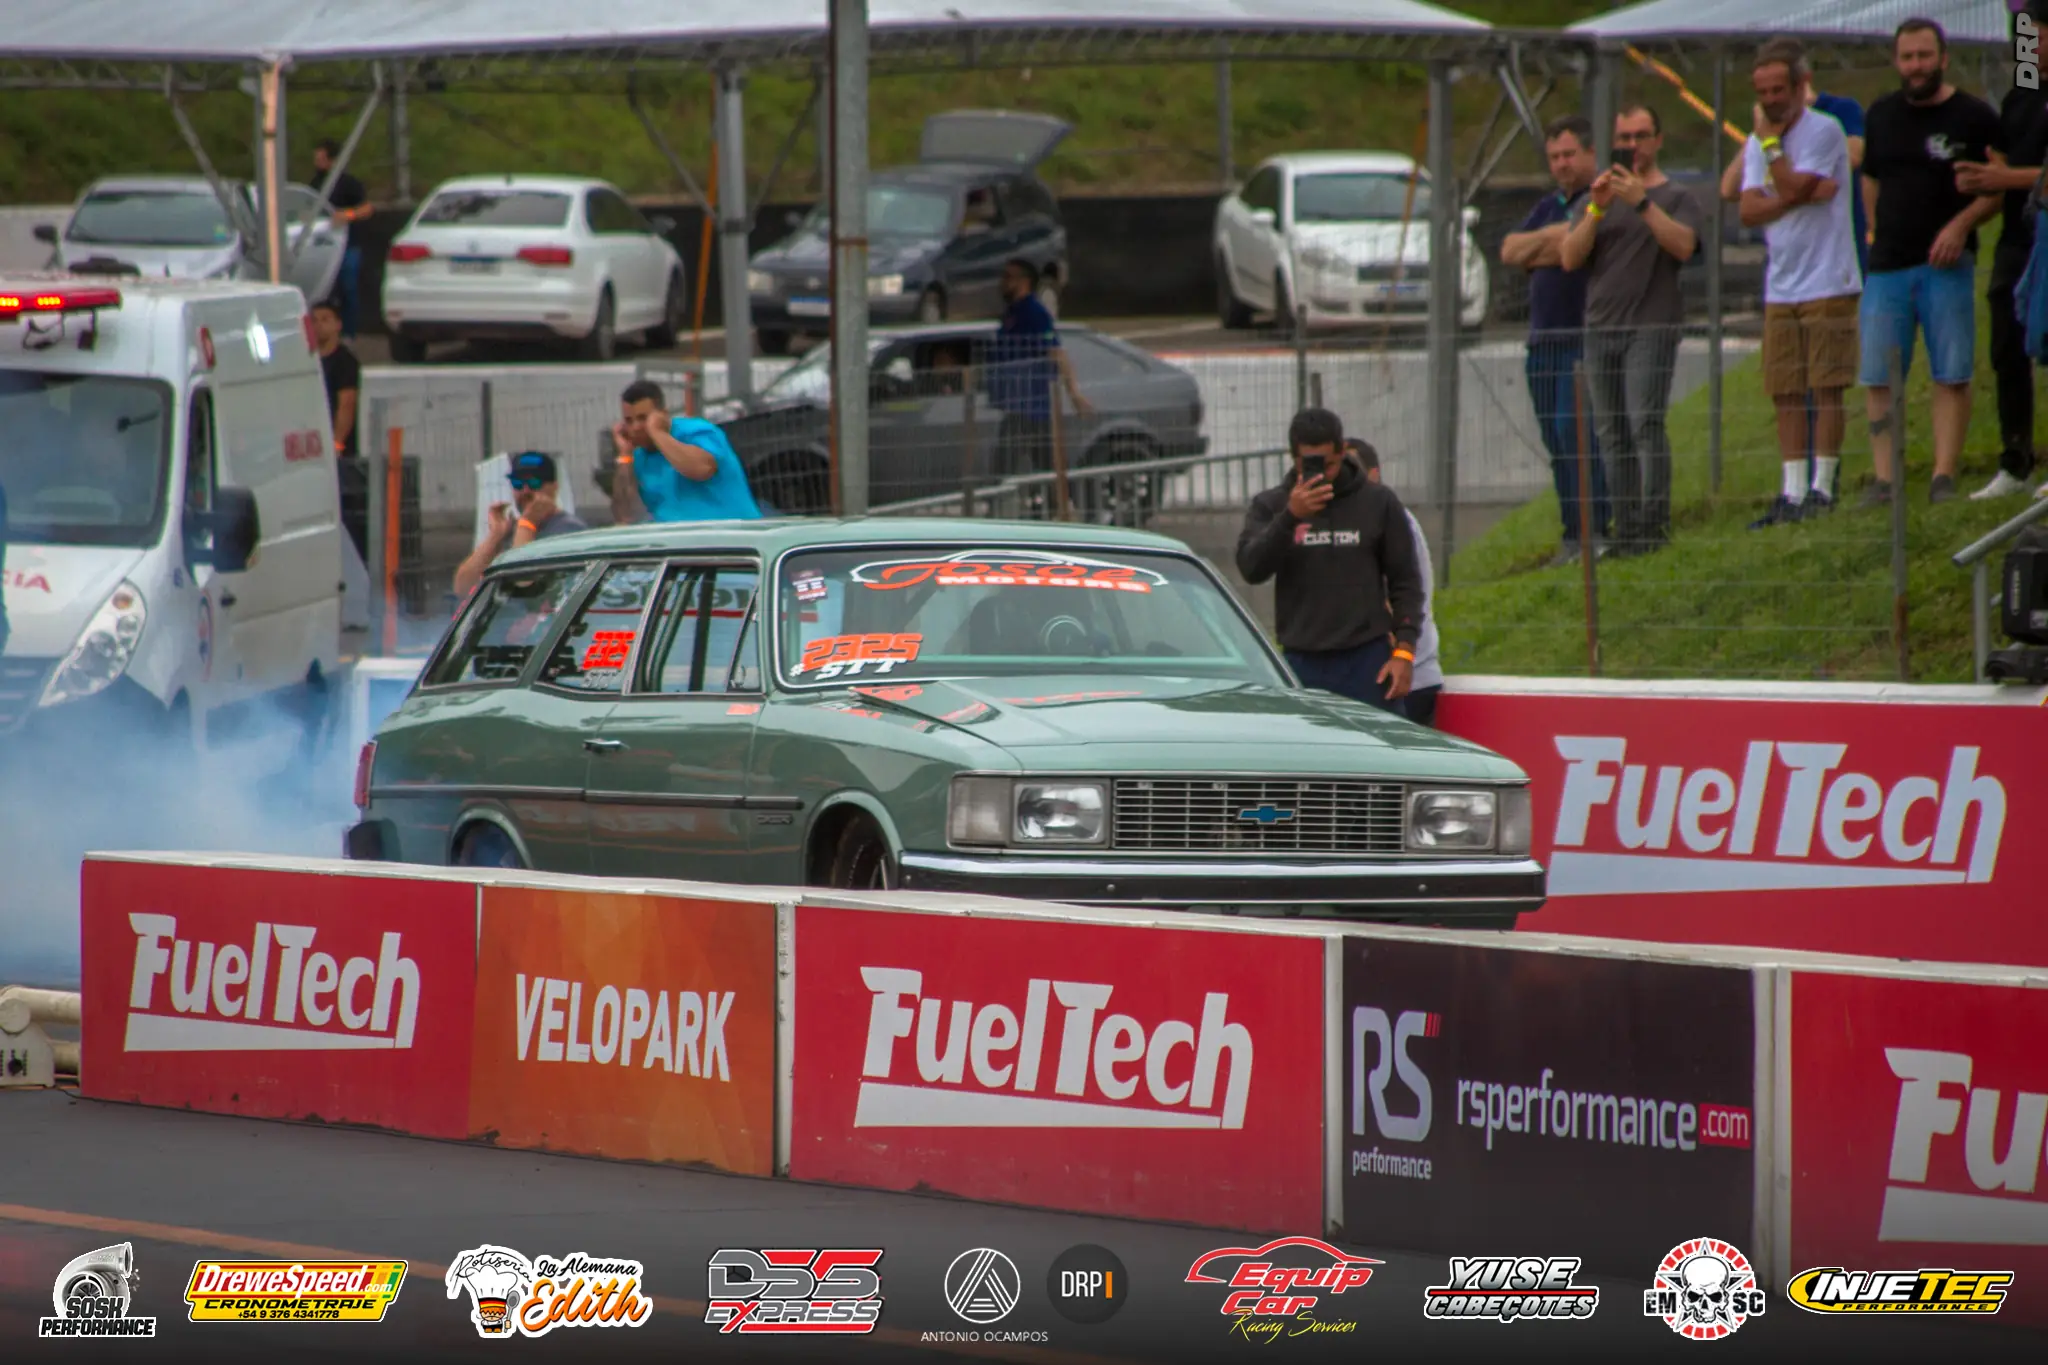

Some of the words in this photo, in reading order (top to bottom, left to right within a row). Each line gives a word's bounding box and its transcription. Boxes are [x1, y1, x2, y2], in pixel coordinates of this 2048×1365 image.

[937, 576, 1150, 593] MOTORS
[802, 633, 923, 671] 2325
[815, 657, 909, 680] STT
[1553, 735, 2007, 884] FuelTech
[129, 912, 421, 1049] FuelTech
[516, 974, 736, 1082] VELOPARK
[860, 966, 1253, 1129] FuelTech
[1353, 1006, 1433, 1142] RS
[1352, 1146, 1432, 1180] performance
[1884, 1048, 2048, 1194] Fu
